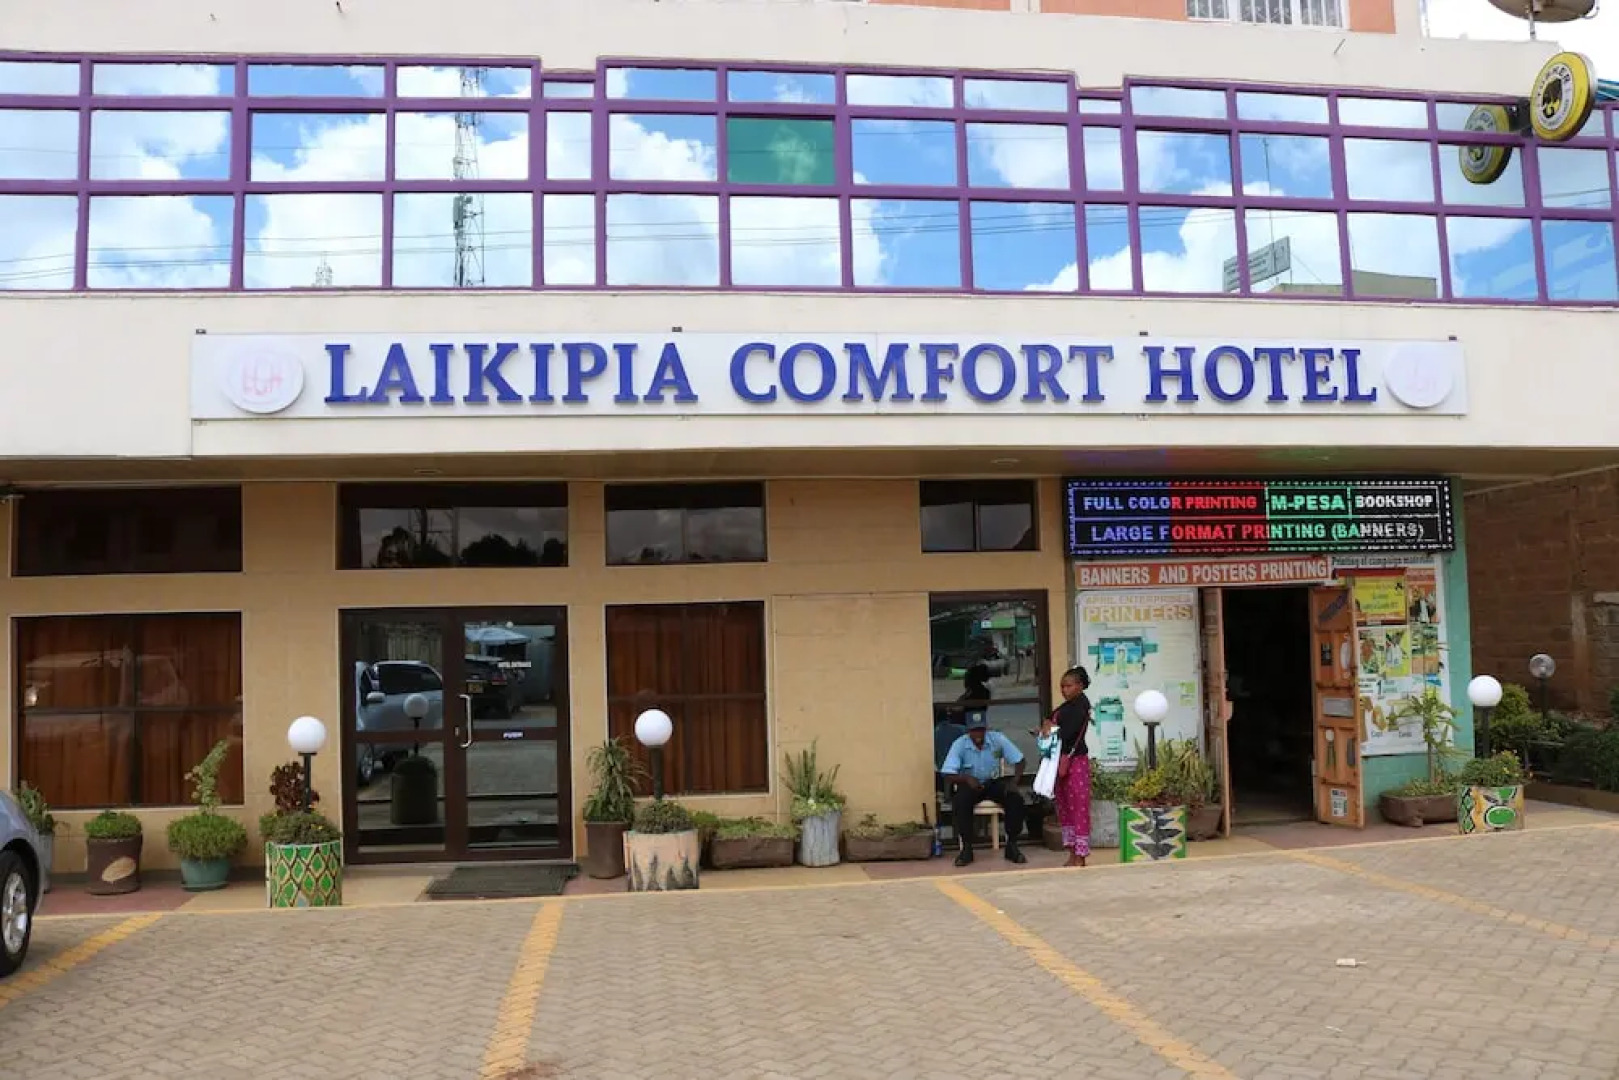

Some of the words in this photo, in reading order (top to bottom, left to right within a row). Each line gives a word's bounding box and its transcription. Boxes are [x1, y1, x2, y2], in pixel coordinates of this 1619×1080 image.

[324, 342, 699, 405] LAIKIPIA
[729, 342, 1115, 404] COMFORT
[1142, 345, 1378, 404] HOTEL
[1083, 496, 1124, 511] FULL
[1128, 496, 1182, 510] COLOR
[1185, 496, 1257, 510] PRINTING
[1270, 495, 1346, 511] M-PESA
[1354, 495, 1433, 508] BOOKSHOP
[1091, 525, 1154, 541] LARGE
[1159, 524, 1236, 541] FORMAT
[1241, 523, 1326, 540] PRINTING
[1331, 522, 1424, 541] (BANNERS)
[1080, 566, 1151, 586] BANNERS
[1158, 565, 1189, 584] AND
[1192, 563, 1258, 583] POSTERS
[1260, 558, 1326, 581] PRINTING
[1083, 604, 1194, 623] PRINTERS
